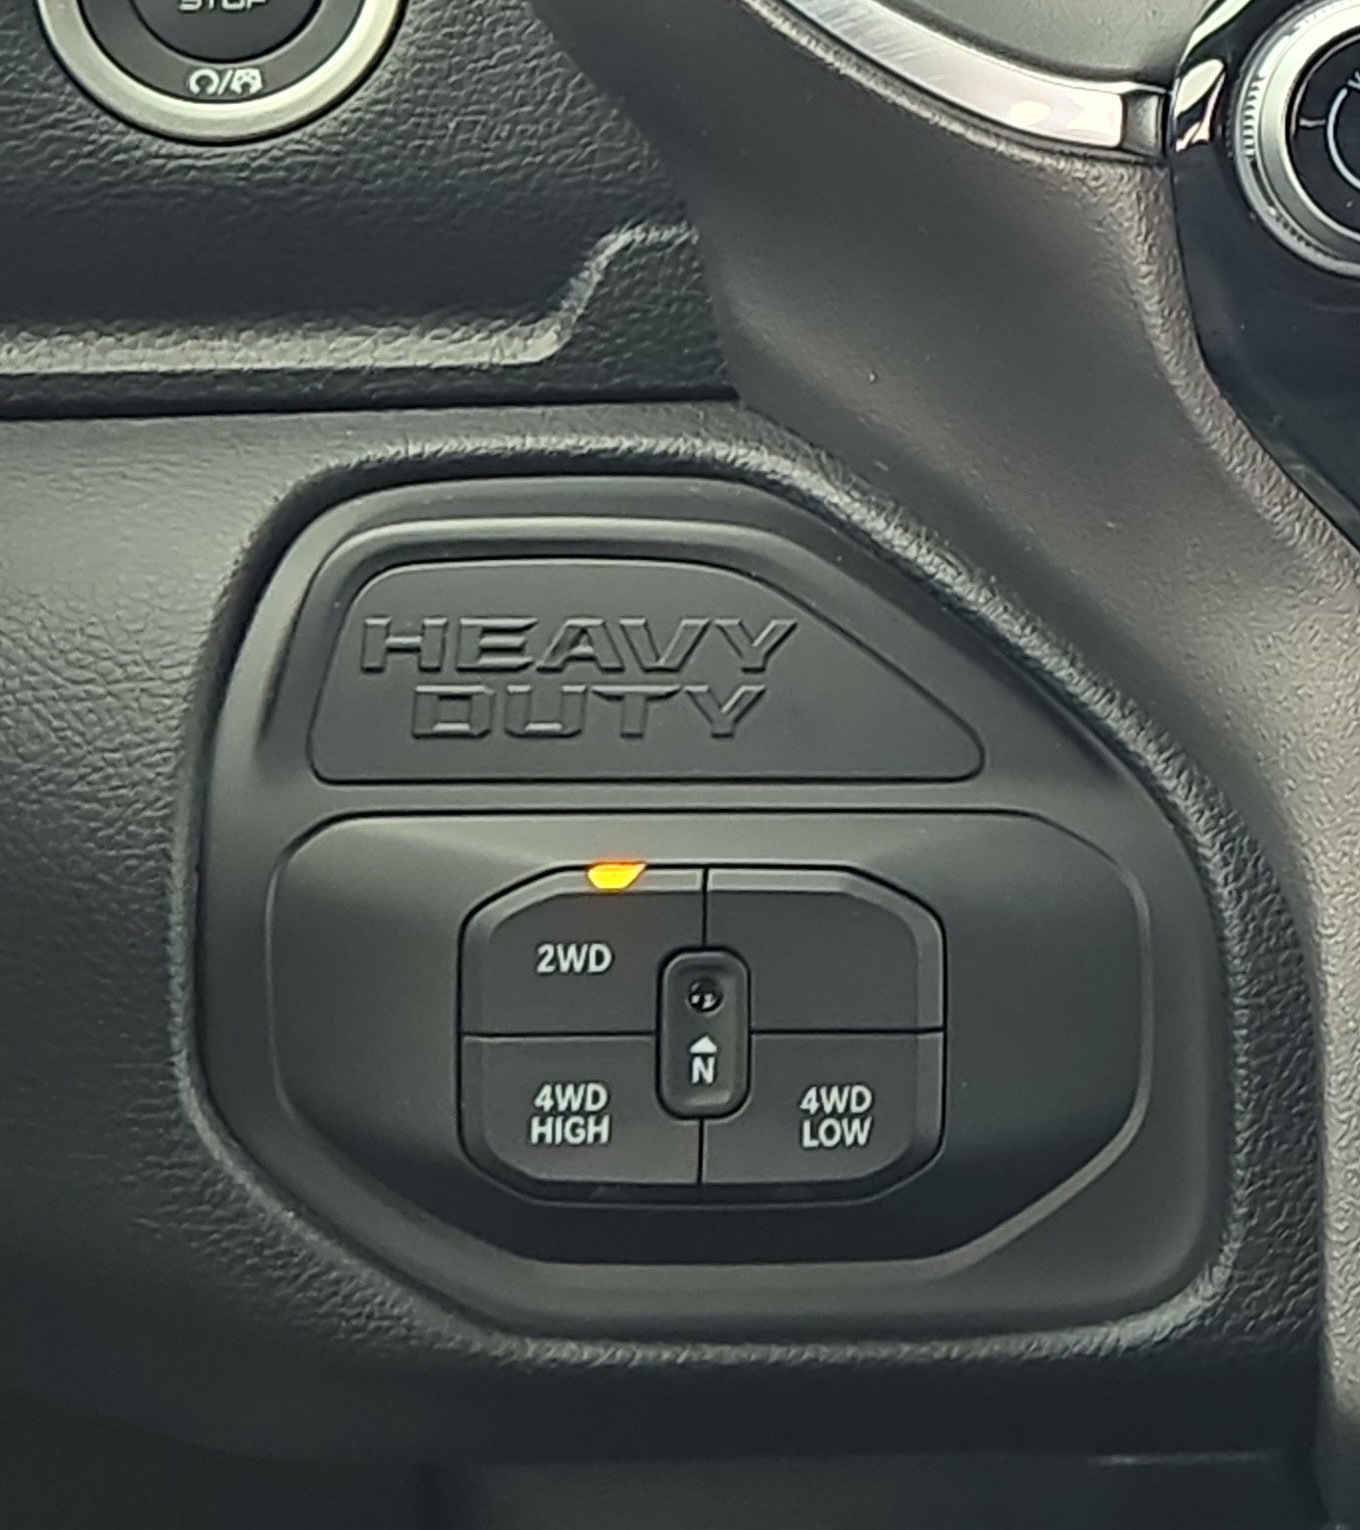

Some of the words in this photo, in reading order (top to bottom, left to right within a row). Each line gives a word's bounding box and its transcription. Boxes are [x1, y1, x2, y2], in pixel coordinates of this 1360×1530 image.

[358, 616, 799, 674] HEAVY
[410, 683, 767, 740] DUTY
[535, 943, 614, 974] 2WD
[691, 1055, 716, 1085] N
[533, 1082, 608, 1112] 4WD
[800, 1085, 874, 1115] 4WD
[530, 1116, 610, 1146] HIGH
[801, 1118, 873, 1148] LOW
